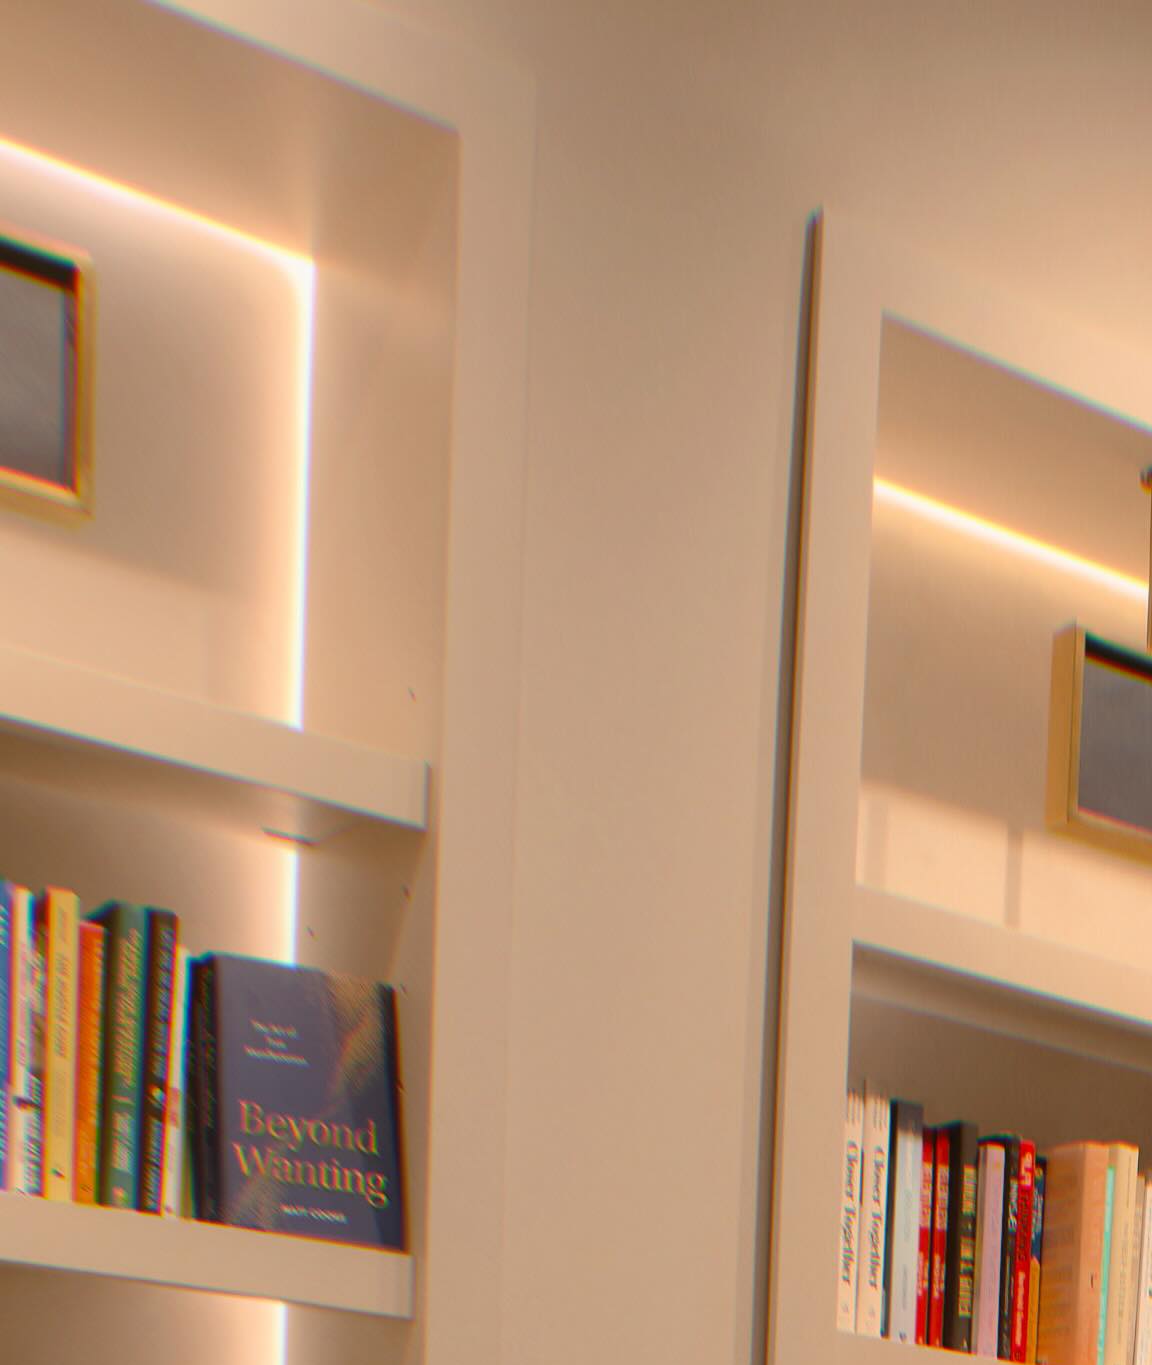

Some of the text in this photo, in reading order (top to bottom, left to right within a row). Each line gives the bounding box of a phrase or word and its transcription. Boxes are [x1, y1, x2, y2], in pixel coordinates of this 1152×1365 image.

[232, 1142, 391, 1209] Wanting
[240, 1102, 380, 1156] Beyond
[841, 1142, 858, 1286] Closer Together
[868, 1147, 885, 1291] Closer Together
